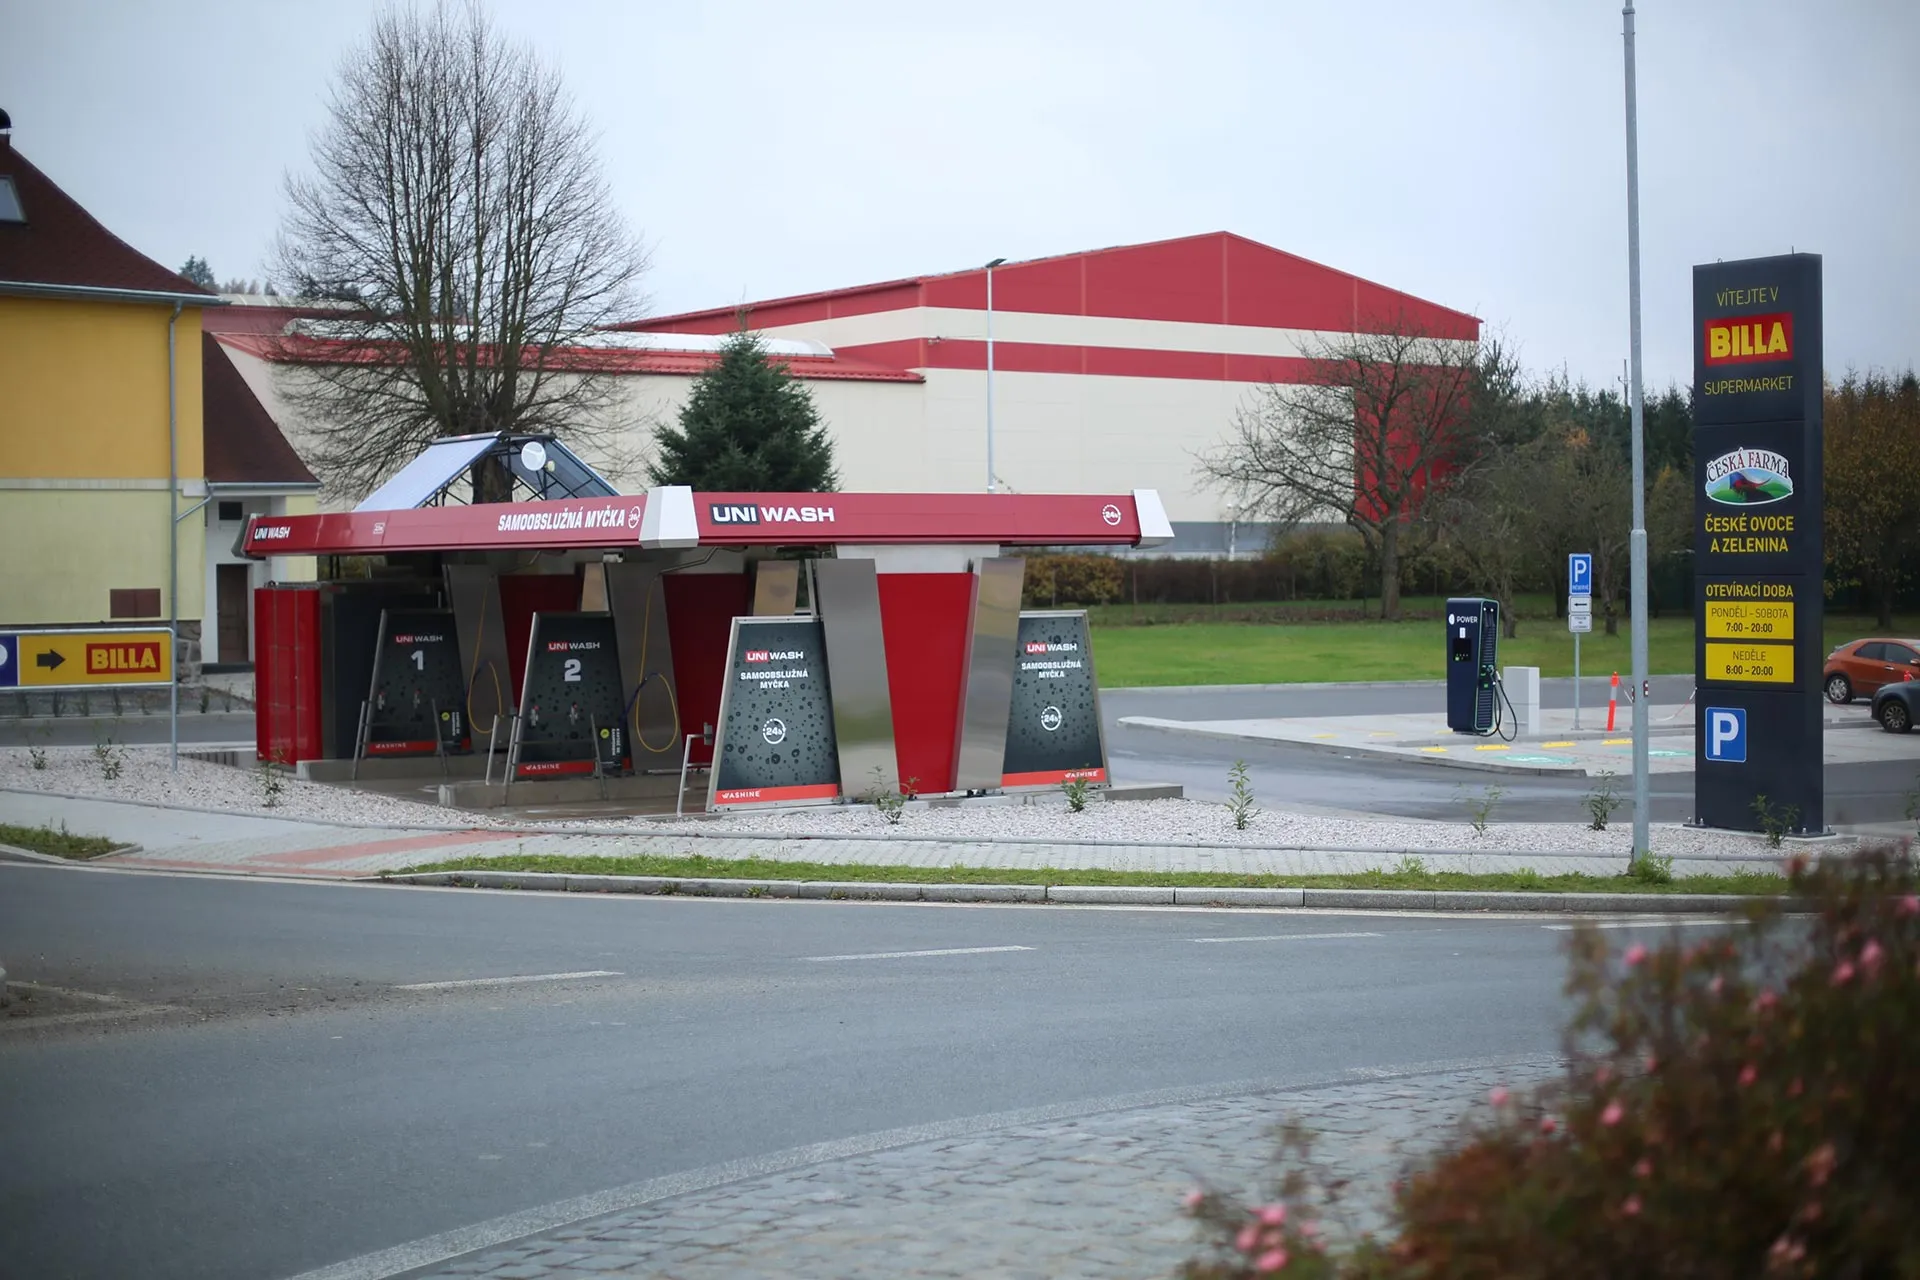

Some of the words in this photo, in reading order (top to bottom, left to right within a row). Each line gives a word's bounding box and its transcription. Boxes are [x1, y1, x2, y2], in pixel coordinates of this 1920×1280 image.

[1716, 287, 1767, 307] VÍTEJTE
[1770, 286, 1779, 303] V
[1710, 322, 1788, 358] BILLA
[1704, 376, 1793, 396] SUPERMARKET
[1707, 449, 1745, 482] ČESKÁ
[1748, 451, 1789, 479] FARMA
[497, 506, 583, 532] SAMOOBSLUŽNÁ
[585, 504, 625, 527] MYČKA
[712, 506, 757, 523] UNI
[761, 507, 834, 522] WASH
[1704, 512, 1747, 533] ČESKÉ
[1750, 515, 1794, 532] OVOCE
[254, 527, 268, 540] UNI
[268, 526, 291, 539] WASH
[1710, 539, 1720, 553] A
[1722, 537, 1788, 553] ZELENINA
[1574, 559, 1587, 583] P
[1705, 581, 1761, 597] OTEVÍRACÍ
[1763, 584, 1794, 597] DOBA
[1456, 615, 1478, 623] POWER
[1711, 605, 1748, 619] PONDĚLÍ
[1755, 607, 1789, 619] SOBOTA
[1726, 622, 1743, 633] 7:00
[1750, 622, 1773, 633] 20:00
[395, 635, 413, 643] UNI
[414, 634, 443, 643] WASH
[548, 642, 568, 651] UNI
[568, 641, 601, 650] WASH
[1026, 643, 1045, 653] UNI
[1046, 641, 1077, 652] WASH
[1732, 647, 1766, 661] NEDĚLE
[91, 648, 156, 669] BILLA
[411, 650, 424, 671] 1
[746, 651, 767, 661] UNI
[769, 650, 804, 660] WASH
[563, 658, 582, 682] 2
[1021, 660, 1081, 670] SAMOOBSLUŽNÁ
[1726, 664, 1743, 675] 8:00
[1750, 664, 1773, 676] 20:00
[740, 669, 808, 681] SAMOOBSLUŽNÁ
[1038, 668, 1065, 679] MYČKA
[760, 678, 790, 689] MYČKA
[1712, 712, 1739, 756] P
